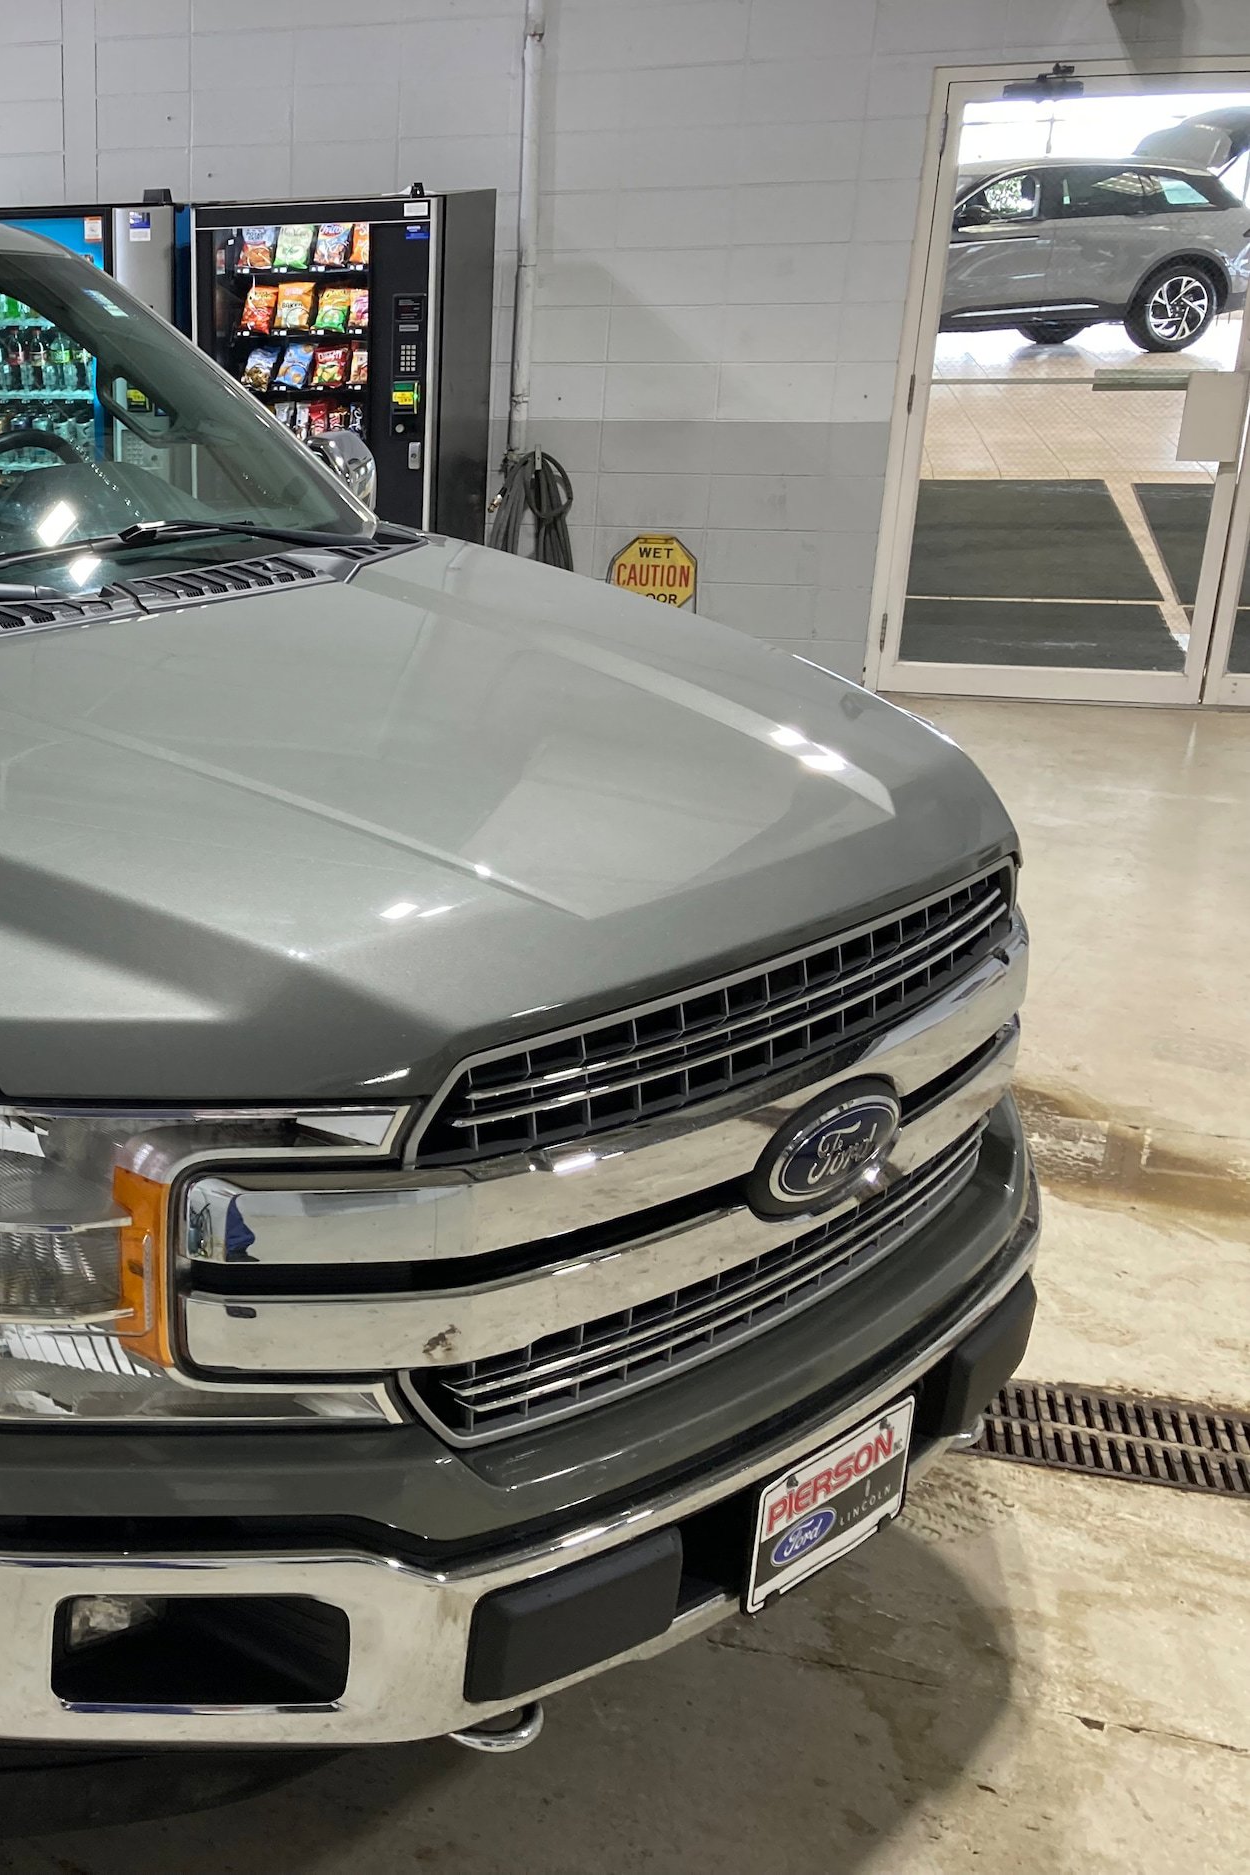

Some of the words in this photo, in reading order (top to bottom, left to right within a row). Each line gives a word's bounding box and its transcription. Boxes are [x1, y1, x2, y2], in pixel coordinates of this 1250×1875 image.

[639, 547, 674, 559] WET
[616, 563, 690, 588] CAUTION
[645, 593, 678, 604] OOR
[807, 1120, 878, 1185] Ford
[766, 1428, 895, 1537] PIERSON
[840, 1484, 892, 1526] LINCOLN
[784, 1518, 824, 1557] Ford
